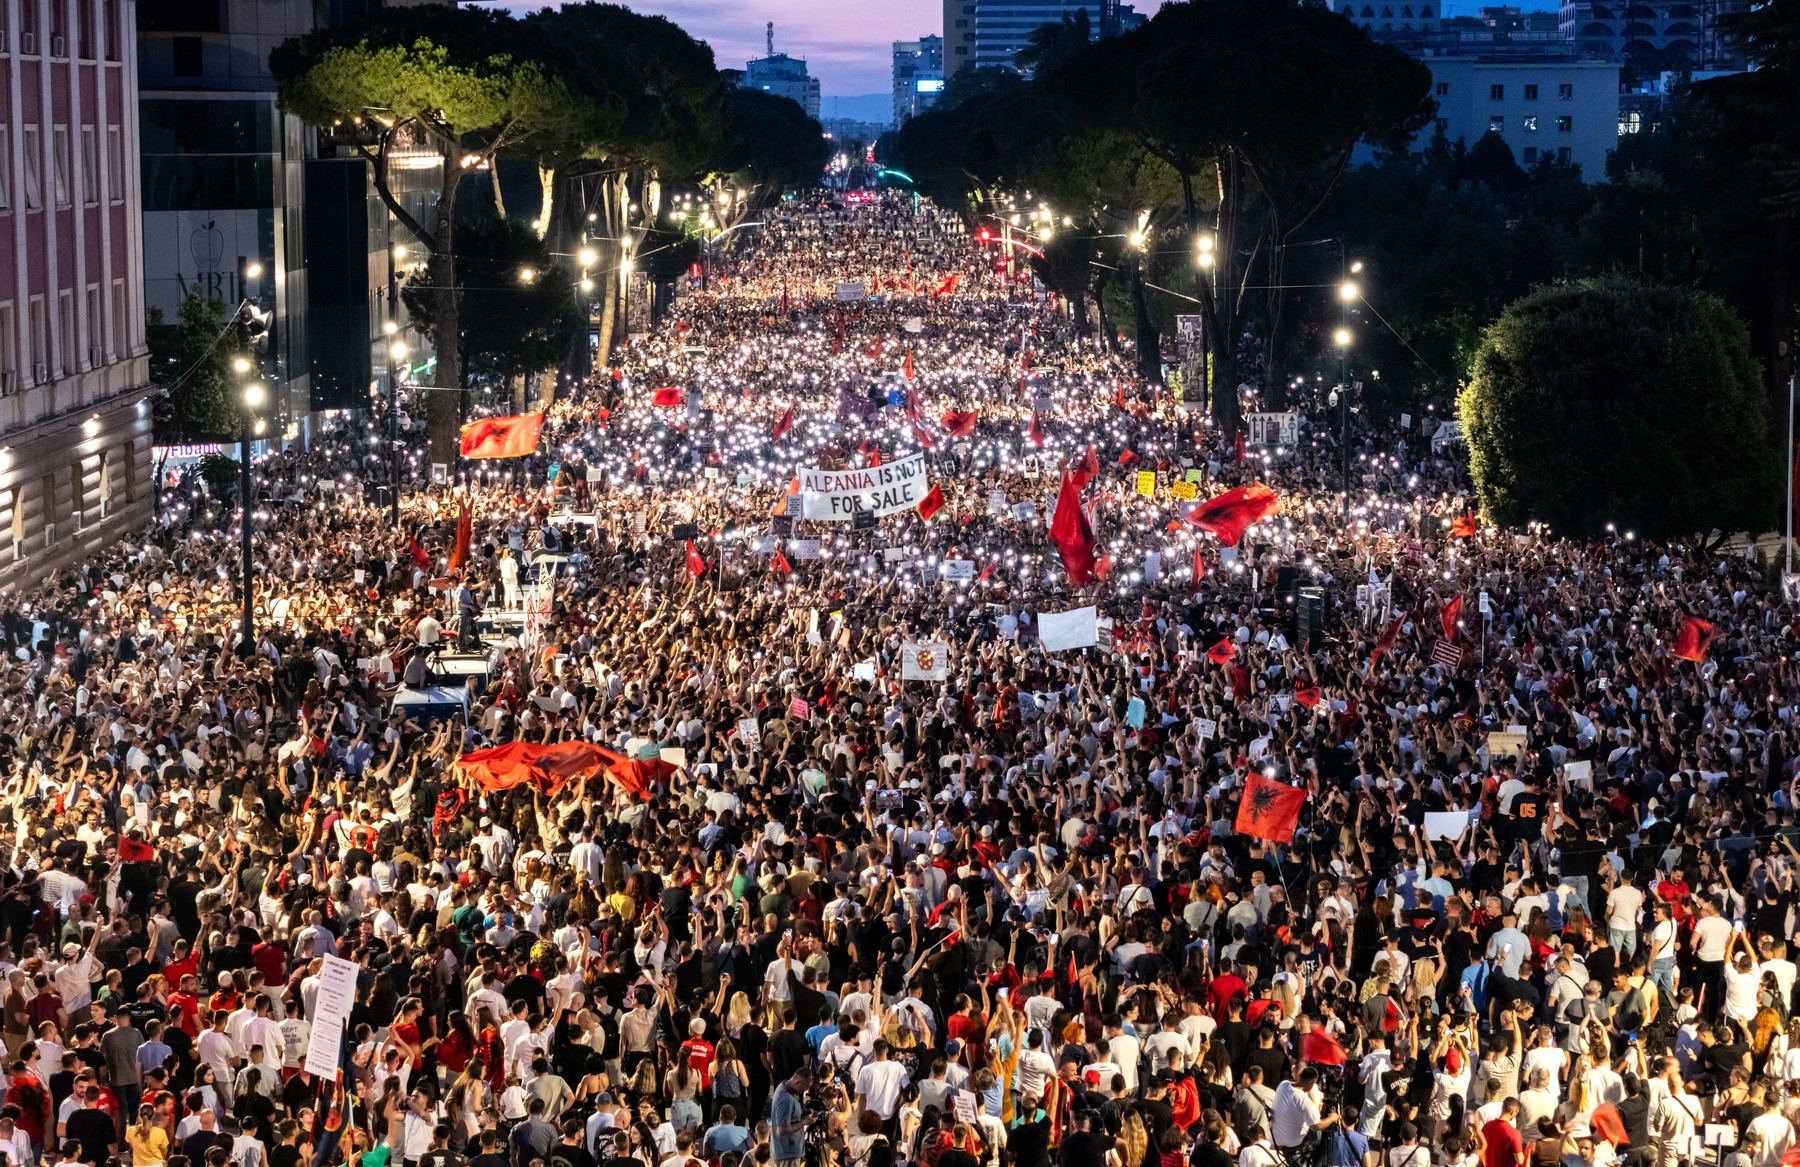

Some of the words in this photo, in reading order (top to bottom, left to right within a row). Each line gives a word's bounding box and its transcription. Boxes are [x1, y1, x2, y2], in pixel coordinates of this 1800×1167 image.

[805, 472, 875, 493] ALBANIA
[878, 467, 893, 486] IS
[895, 457, 924, 482] NOT
[831, 495, 863, 514] FOR
[871, 483, 914, 510] SALE
[1520, 803, 1536, 817] 05
